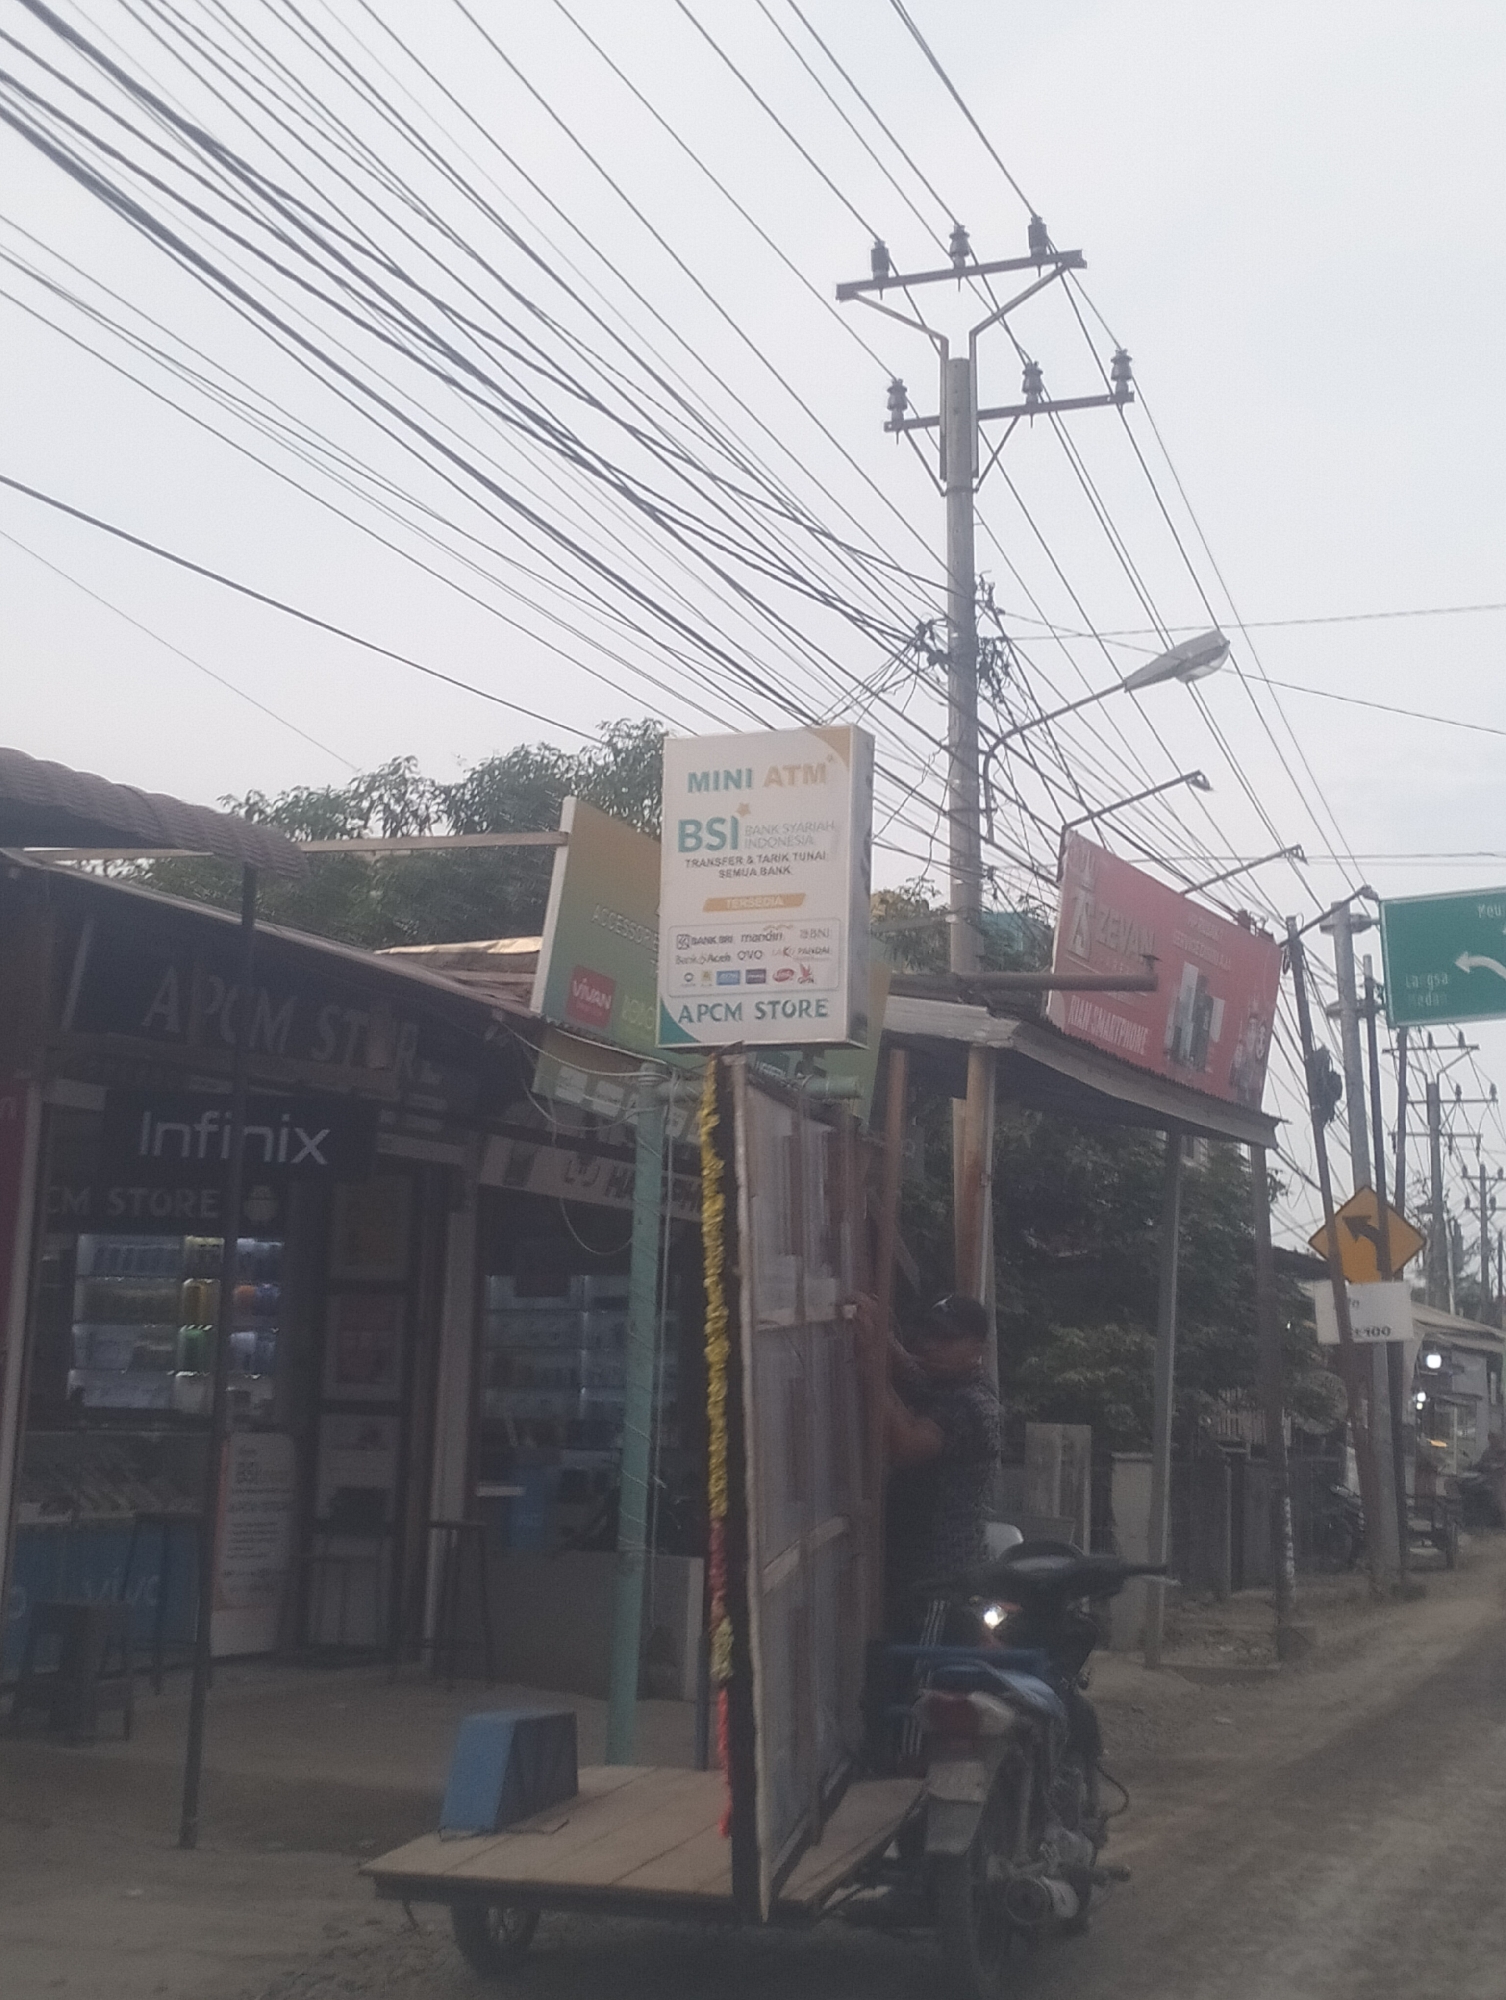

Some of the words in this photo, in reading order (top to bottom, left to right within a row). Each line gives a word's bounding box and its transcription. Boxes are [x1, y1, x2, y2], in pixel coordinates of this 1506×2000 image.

[687, 768, 753, 793] MINI
[763, 763, 826, 788] ATM
[677, 815, 739, 853] BSI
[745, 824, 778, 837] BANK
[782, 820, 835, 835] SYARIAH
[744, 834, 814, 850] INDONESIA
[685, 855, 743, 868] TRANSFER
[746, 857, 754, 865] &
[756, 853, 790, 864] TARIK
[792, 850, 826, 862] TUNAI
[719, 867, 757, 879] SEMUA
[760, 864, 792, 876] BANK
[726, 895, 784, 910] TERSEDIA
[810, 927, 830, 939] BNI
[737, 949, 763, 960] OVO
[141, 965, 300, 1056] APCM
[678, 1002, 743, 1024] APCM
[754, 998, 829, 1021] STORE
[139, 1110, 331, 1165] Infinix
[106, 1186, 221, 1219] STORE
